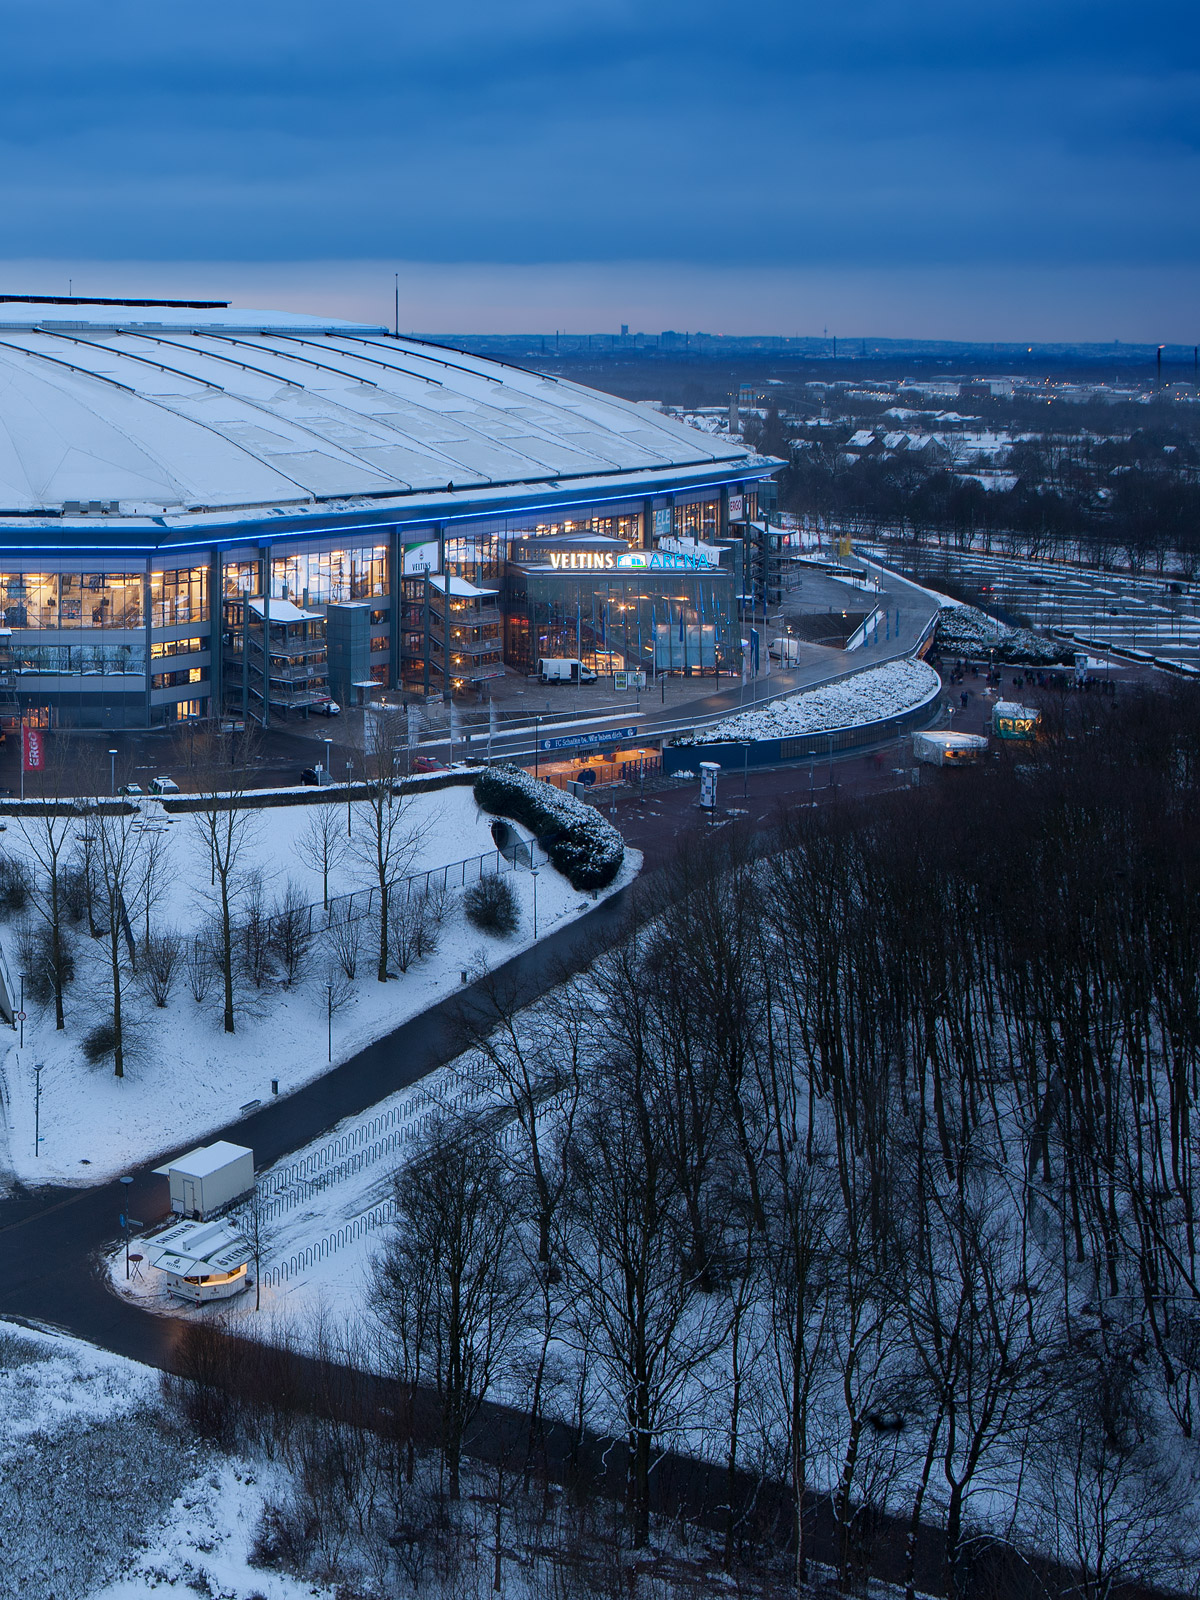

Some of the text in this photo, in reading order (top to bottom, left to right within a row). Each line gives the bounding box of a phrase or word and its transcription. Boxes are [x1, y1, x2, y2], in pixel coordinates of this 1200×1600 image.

[729, 499, 742, 512] ERGO
[657, 508, 671, 526] ELE
[412, 562, 431, 571] VELTINS
[550, 553, 614, 569] VELTINS
[650, 553, 710, 569] ARENA
[562, 738, 580, 747] Schalke
[588, 735, 598, 743] Wir
[598, 733, 611, 742] leben
[28, 731, 40, 766] ERGO
[156, 1227, 190, 1245] VELTINS
